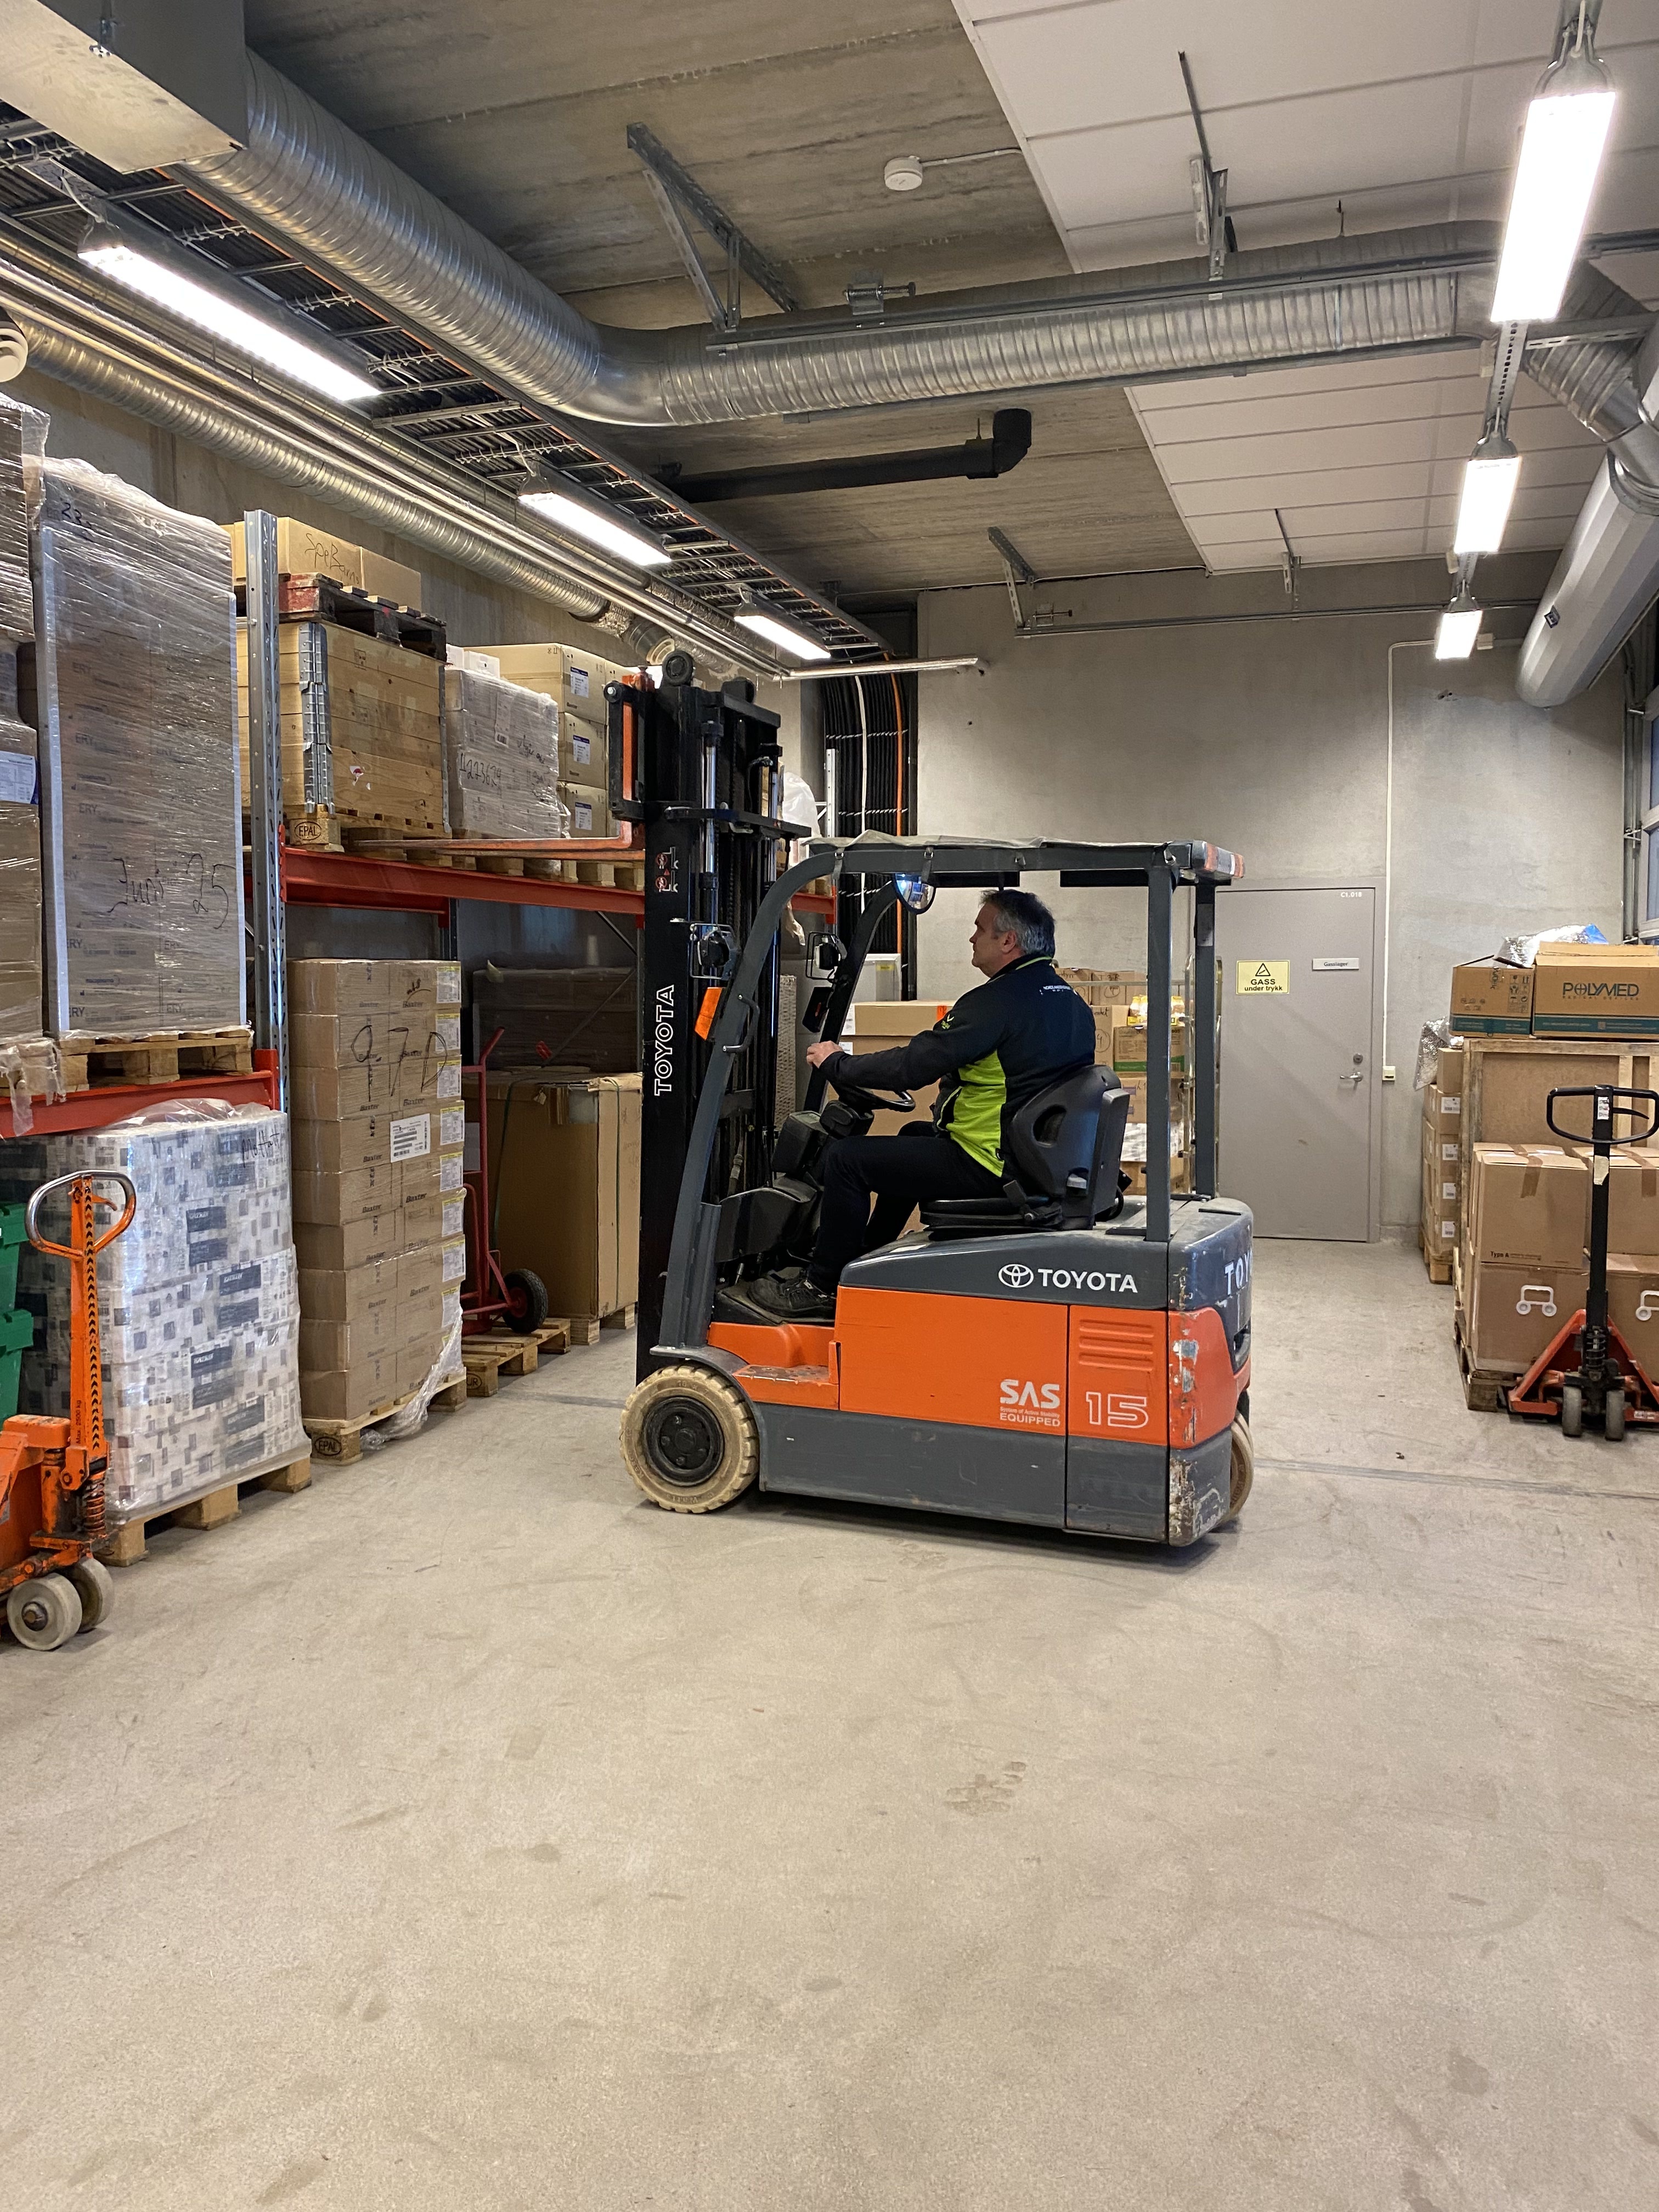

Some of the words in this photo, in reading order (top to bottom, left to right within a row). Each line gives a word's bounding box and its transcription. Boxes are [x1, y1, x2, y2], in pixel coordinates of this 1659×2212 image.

[79, 803, 98, 814] ERY
[298, 825, 318, 837] EPAL
[1562, 982, 1640, 997] POLYMED
[654, 984, 675, 1096] TOYOTA
[360, 1103, 379, 1111] Baxter
[403, 1098, 425, 1107] Baxter
[363, 1154, 382, 1163] Baxter
[405, 1193, 427, 1203] Baxter
[362, 1204, 381, 1214] Baxter
[1037, 1268, 1138, 1293] TOYOTA
[410, 1285, 431, 1297] Baxter
[1000, 1378, 1060, 1409] SAS
[76, 1400, 82, 1408] kg
[1086, 1391, 1149, 1429] 15
[1000, 1412, 1060, 1427] EQUIPPED
